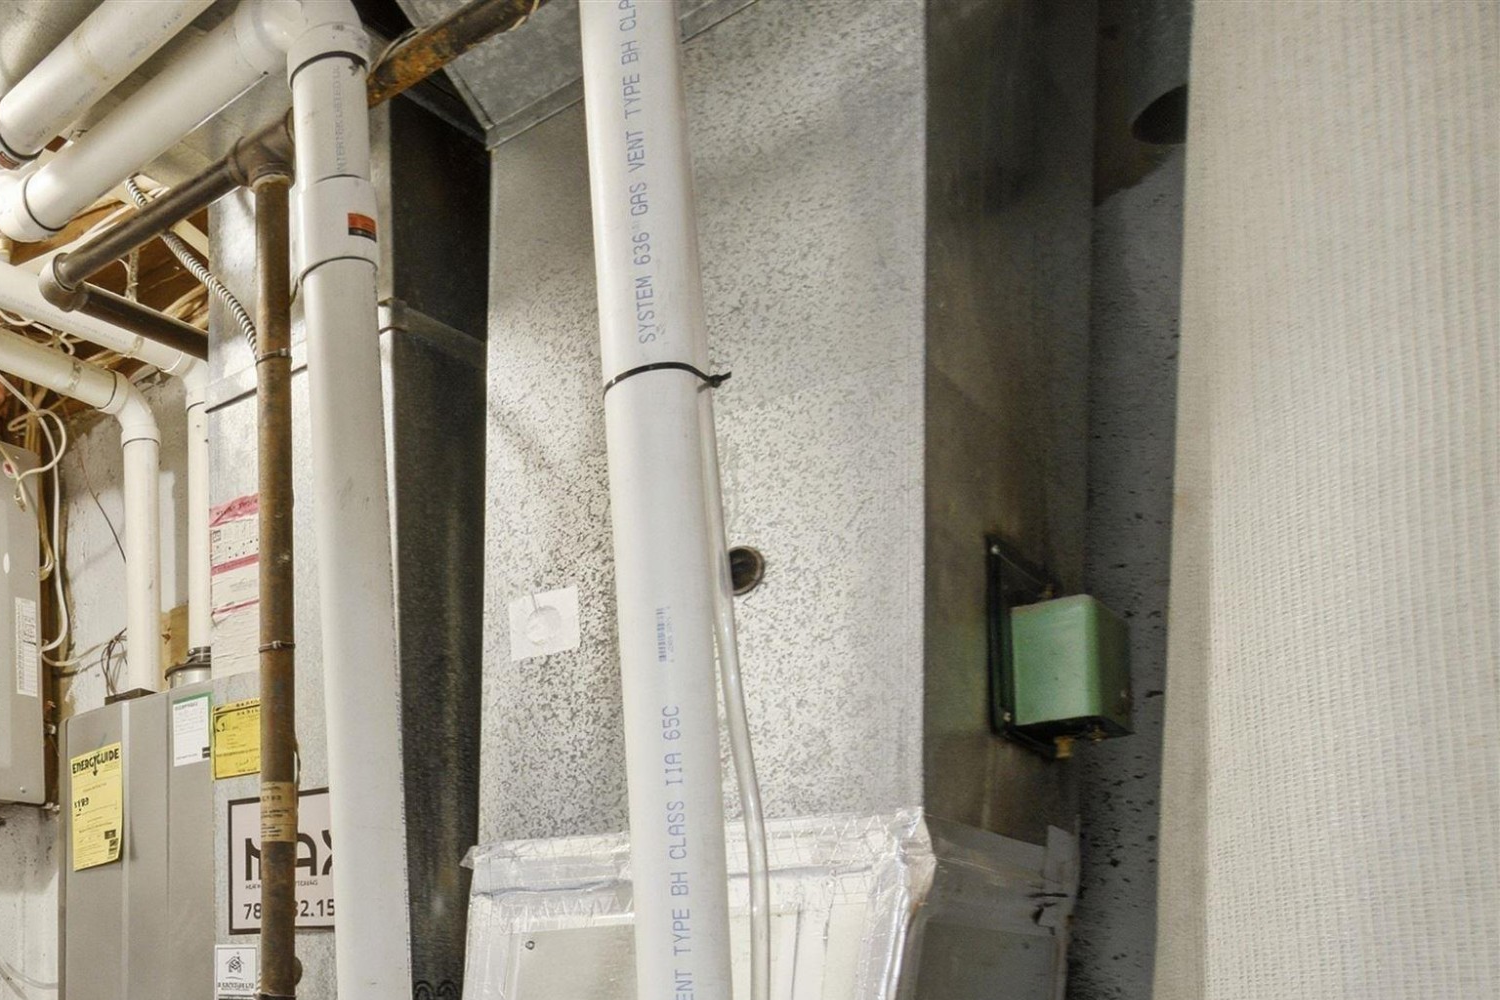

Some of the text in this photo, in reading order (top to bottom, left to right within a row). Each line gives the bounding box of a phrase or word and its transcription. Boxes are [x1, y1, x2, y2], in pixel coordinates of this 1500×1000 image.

[621, 39, 640, 66] BH
[622, 72, 641, 120] TYPE
[626, 130, 646, 174] VENT
[630, 181, 648, 217] GAS
[635, 275, 656, 345] SYSTEM
[662, 704, 682, 742] 65C
[666, 799, 688, 860] CLASS
[671, 871, 691, 897] BH
[673, 907, 692, 957] TYPE
